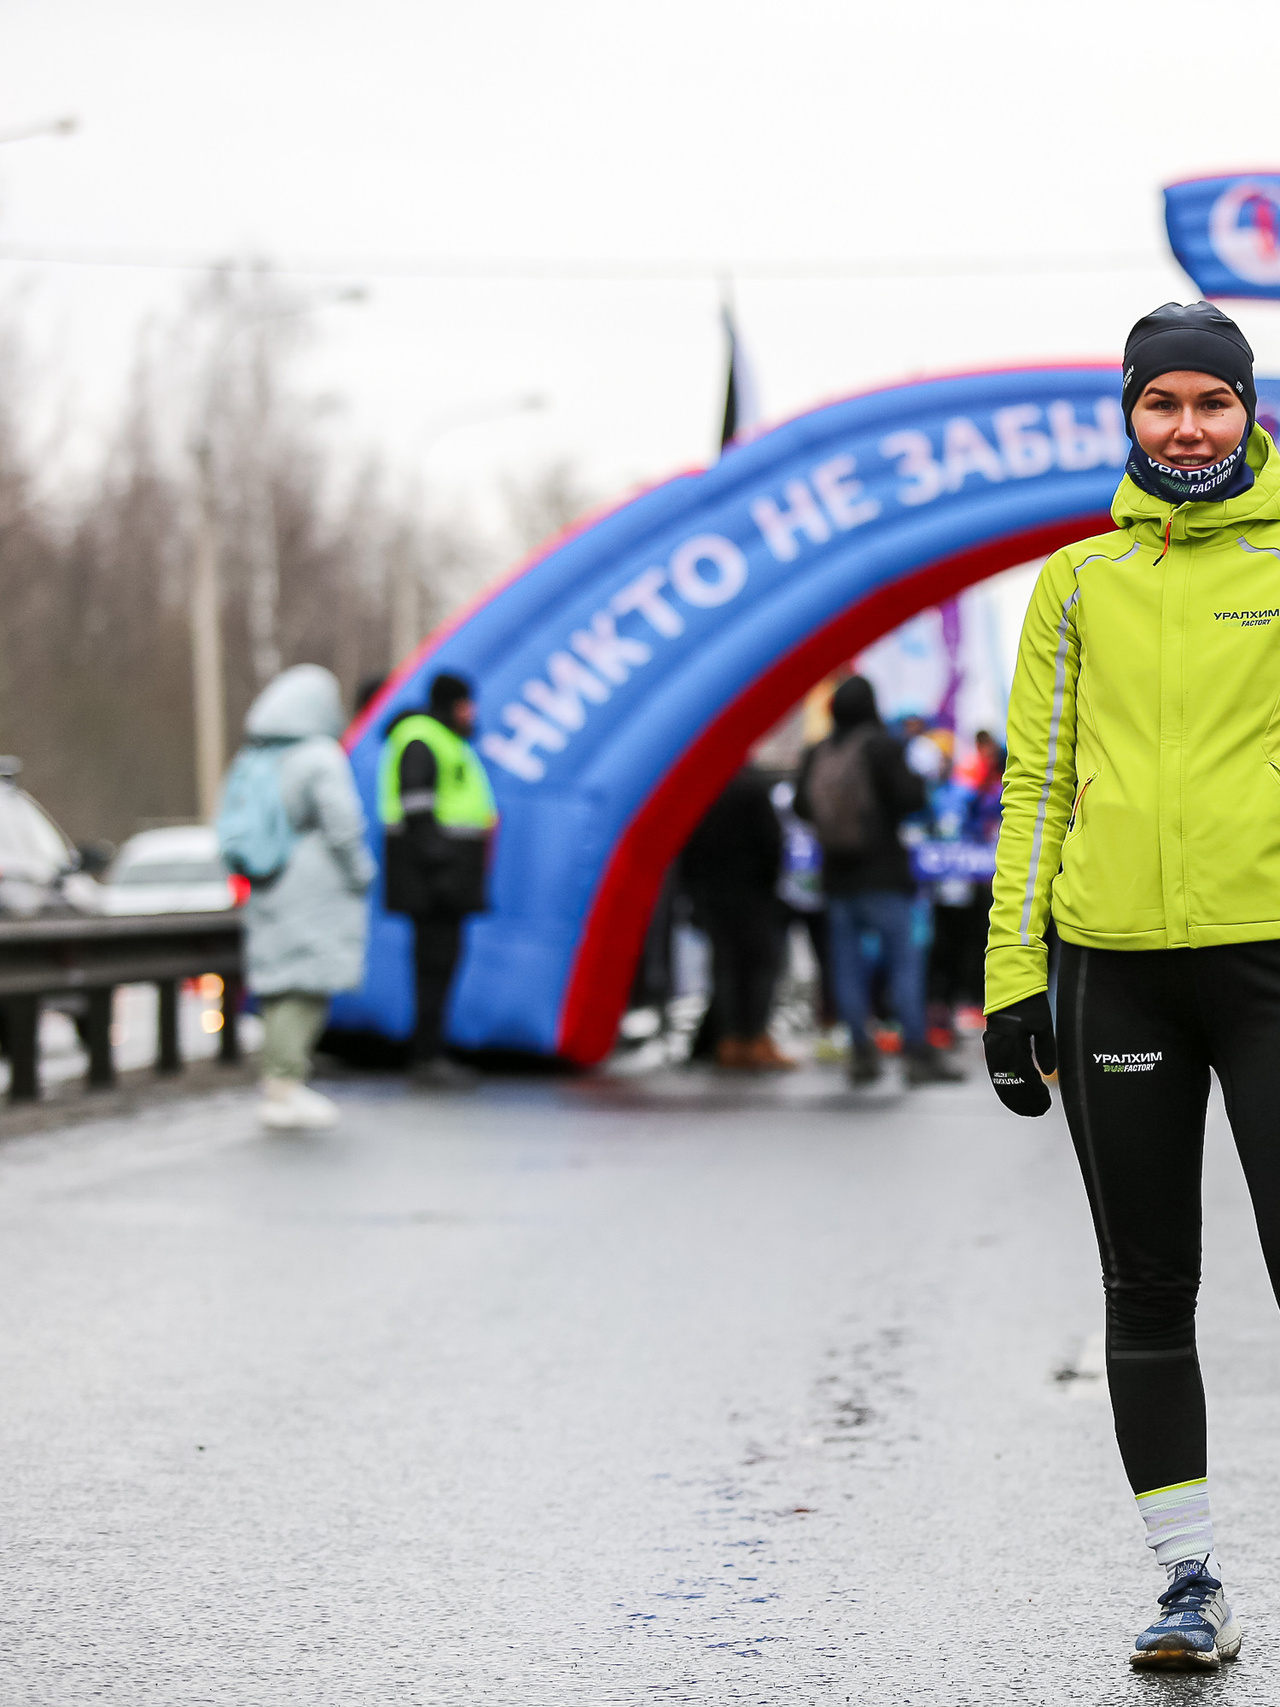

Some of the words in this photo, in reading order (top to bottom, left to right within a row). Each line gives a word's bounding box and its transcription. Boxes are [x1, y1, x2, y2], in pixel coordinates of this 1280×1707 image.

[480, 532, 749, 784] НИКТО
[750, 452, 882, 564] НЕ
[879, 396, 1126, 507] ЗАБЫ
[1213, 608, 1280, 621] УРАЛХИМ
[1092, 1051, 1163, 1064] УРАЛХИМ
